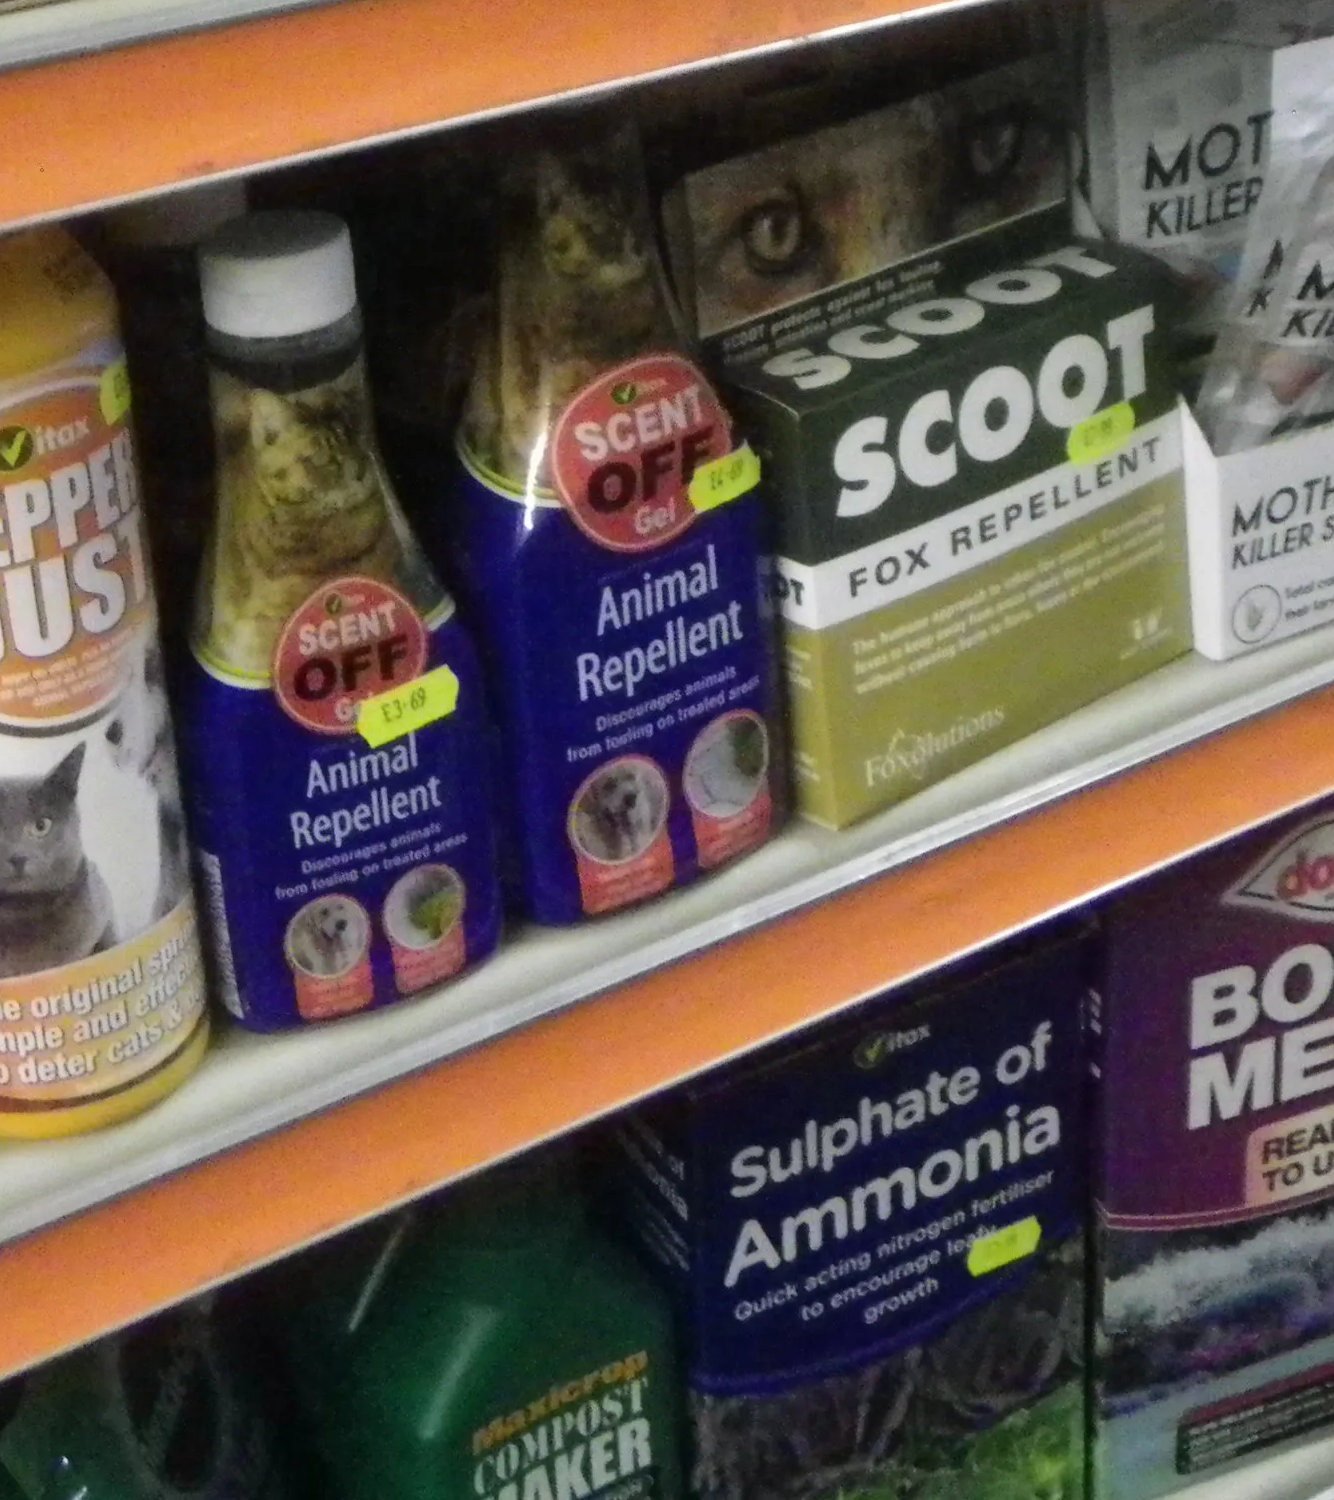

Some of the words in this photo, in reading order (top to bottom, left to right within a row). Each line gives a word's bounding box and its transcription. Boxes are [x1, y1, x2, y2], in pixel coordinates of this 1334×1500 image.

[761, 245, 1117, 392] SCOOT
[573, 386, 705, 462] SCENT
[831, 302, 1156, 519] SCOOT
[586, 424, 715, 515] OFF
[847, 541, 932, 600] FOX
[949, 435, 1163, 558] REPELLENT
[1231, 521, 1315, 571] KILLER
[597, 543, 720, 637] Animal
[298, 601, 398, 658] SCENT
[575, 598, 744, 703] Repellent
[293, 635, 408, 703] OFF
[595, 684, 683, 733] Discourages
[306, 730, 419, 799] Animal
[289, 773, 443, 850] Repellent
[300, 840, 388, 876] Discourages
[30, 956, 144, 1020] original
[17, 1048, 101, 1085] deter
[107, 1023, 163, 1065] cats
[72, 1007, 129, 1044] and
[729, 1064, 981, 1201] Sulphate
[995, 1019, 1054, 1087] of
[722, 1102, 1061, 1289] Ammonia
[1260, 1156, 1306, 1194] TO
[732, 1283, 799, 1323] Quick
[803, 1251, 873, 1294] acting
[875, 1208, 966, 1261] nitrogen
[970, 1169, 1056, 1219] fertiliser
[829, 1249, 942, 1311] encourage
[861, 1275, 941, 1326] growth
[473, 1375, 650, 1497] COMPOST
